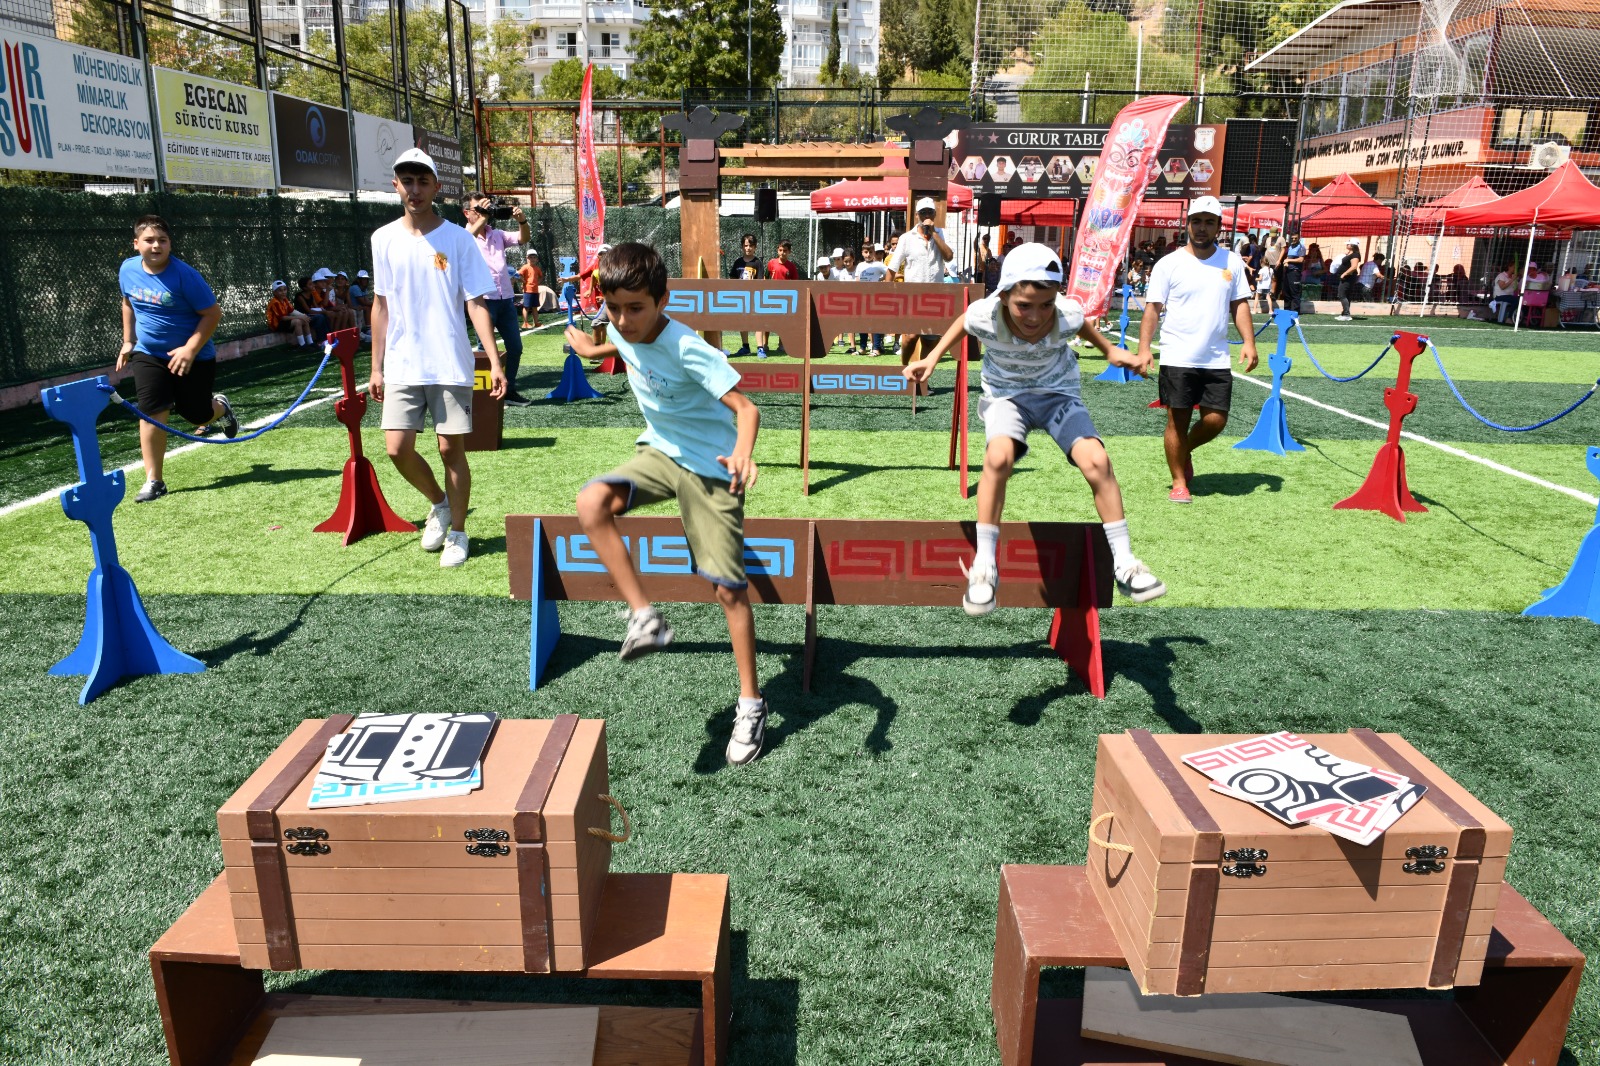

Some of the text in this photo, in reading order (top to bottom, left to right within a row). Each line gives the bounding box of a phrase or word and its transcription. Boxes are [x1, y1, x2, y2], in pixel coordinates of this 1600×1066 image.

[73, 51, 143, 87] MÜHENDİSLİK
[77, 80, 128, 110] MİMARLIK
[184, 83, 247, 115] EGECAN
[81, 112, 150, 140] DEKORASYON
[175, 109, 259, 136] SÜRÜCÜ KURSU
[58, 143, 71, 152] PLAN
[1007, 132, 1060, 145] GURUR
[167, 142, 271, 163] EĞİTİMDE VE HİZMETTE TEK ADRES
[1376, 151, 1391, 166] SON
[843, 197, 861, 207] T.C.
[1153, 218, 1167, 226] T.C.
